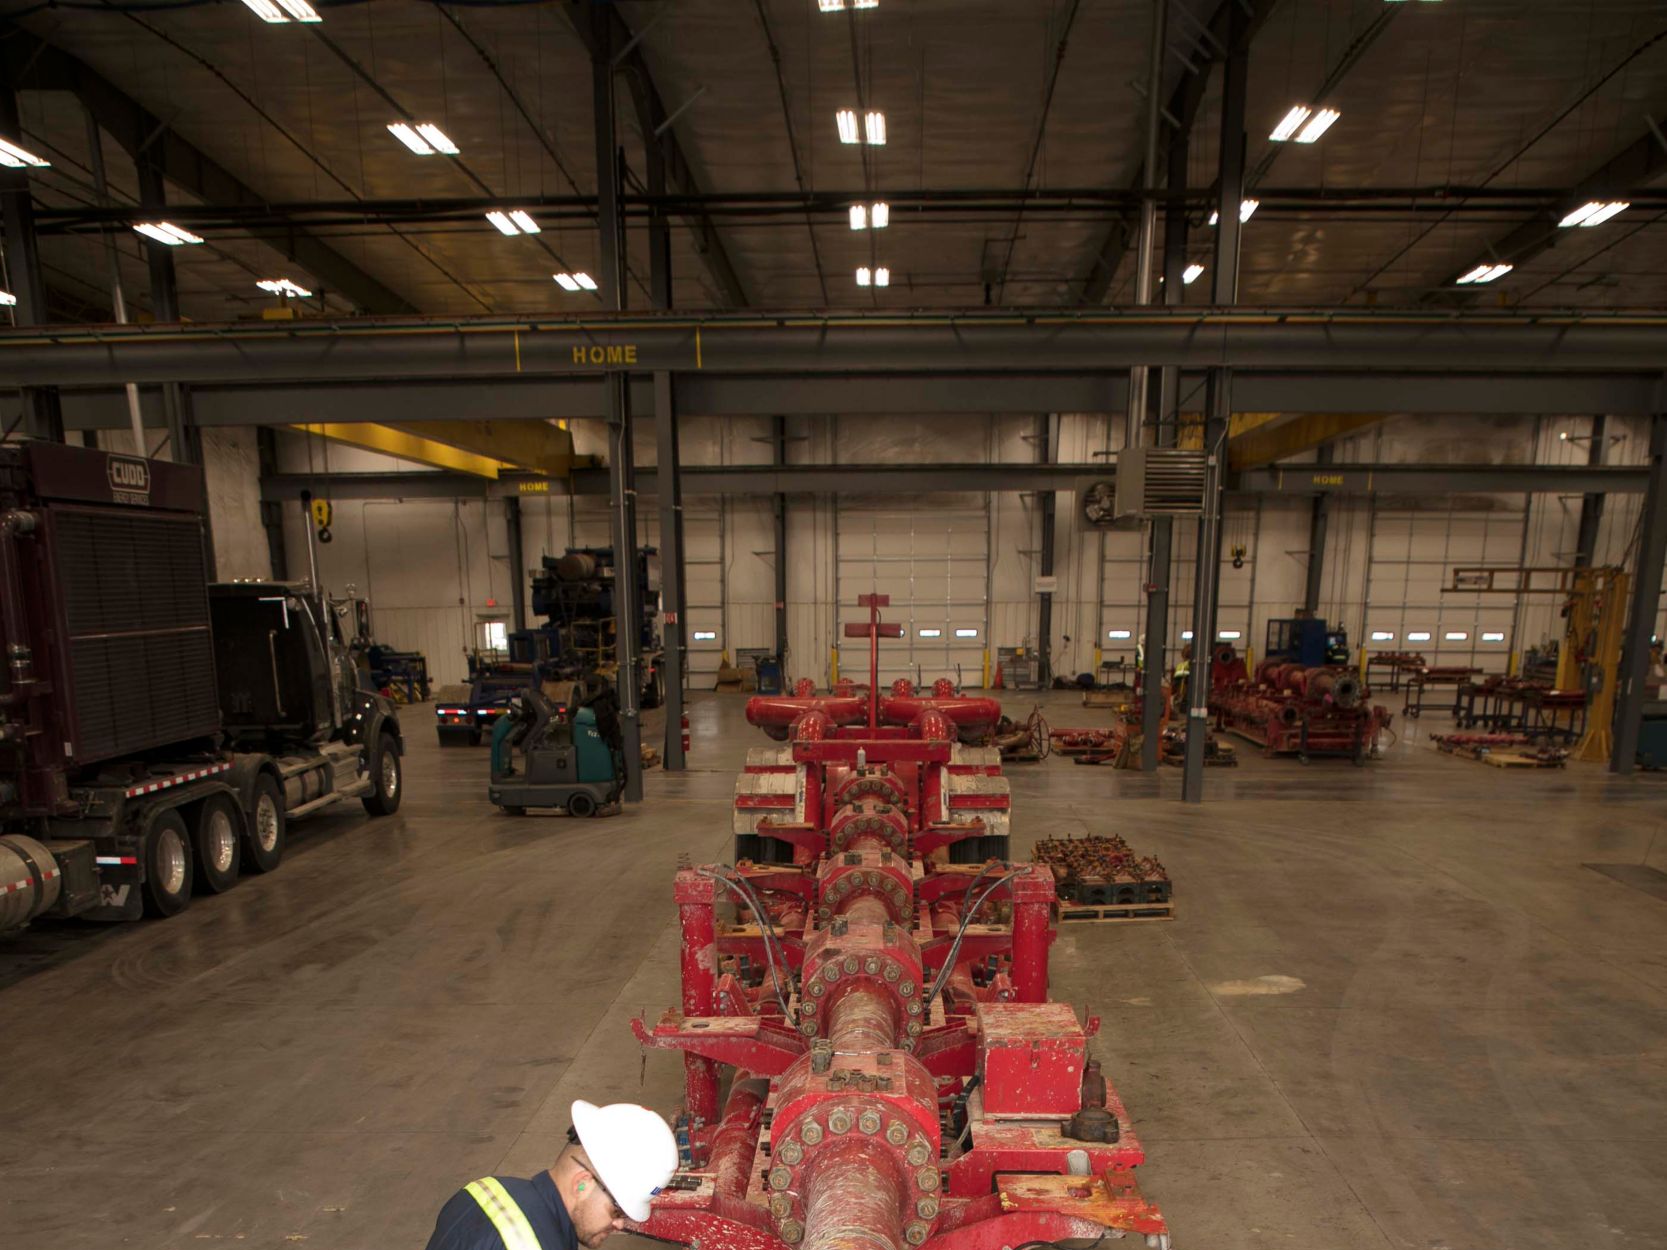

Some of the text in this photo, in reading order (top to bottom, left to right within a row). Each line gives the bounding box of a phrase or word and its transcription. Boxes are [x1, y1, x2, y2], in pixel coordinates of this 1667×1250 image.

[573, 345, 637, 364] HOME
[112, 461, 145, 486] CUDD
[1313, 475, 1344, 485] HOME
[519, 482, 549, 492] HOME
